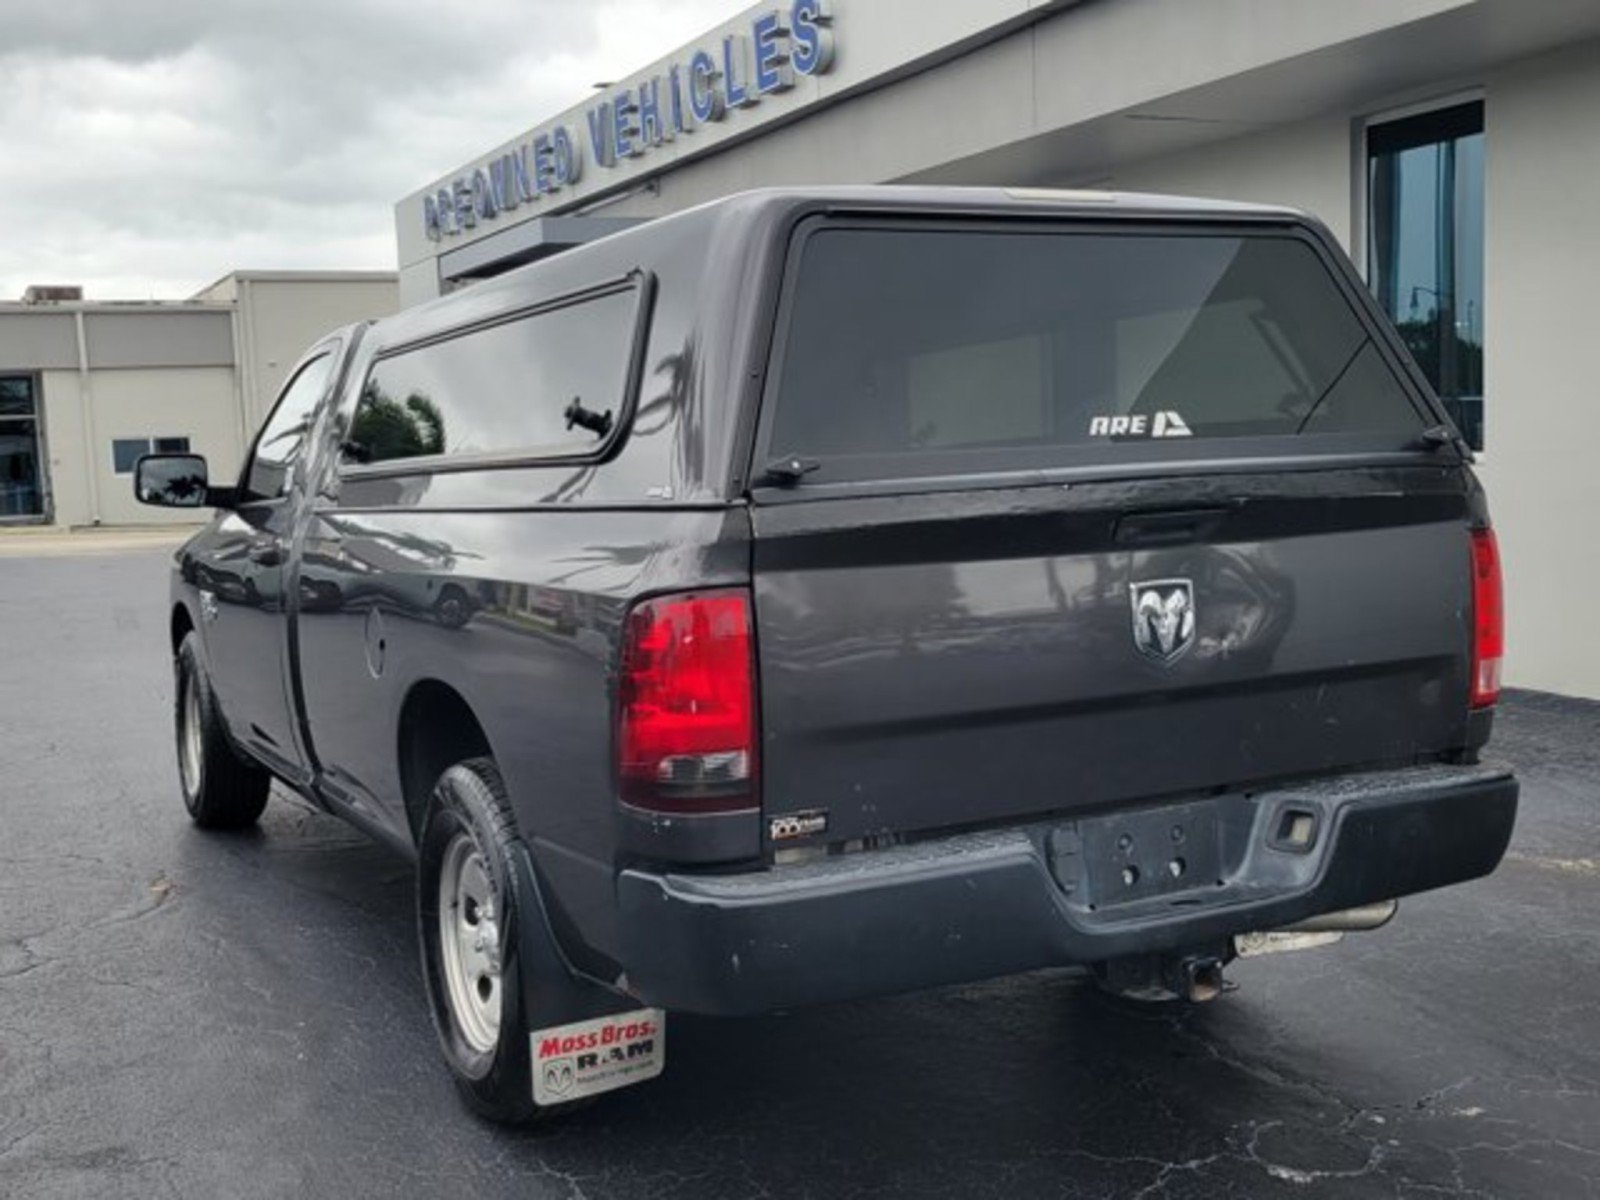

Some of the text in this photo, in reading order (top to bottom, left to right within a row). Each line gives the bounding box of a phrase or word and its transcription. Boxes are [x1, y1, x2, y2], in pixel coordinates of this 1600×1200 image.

[424, 0, 834, 241] PREOWNED VEHICLES
[1089, 414, 1147, 436] ARE
[539, 1022, 656, 1058] Moss Bros.
[577, 1039, 654, 1070] RAM
